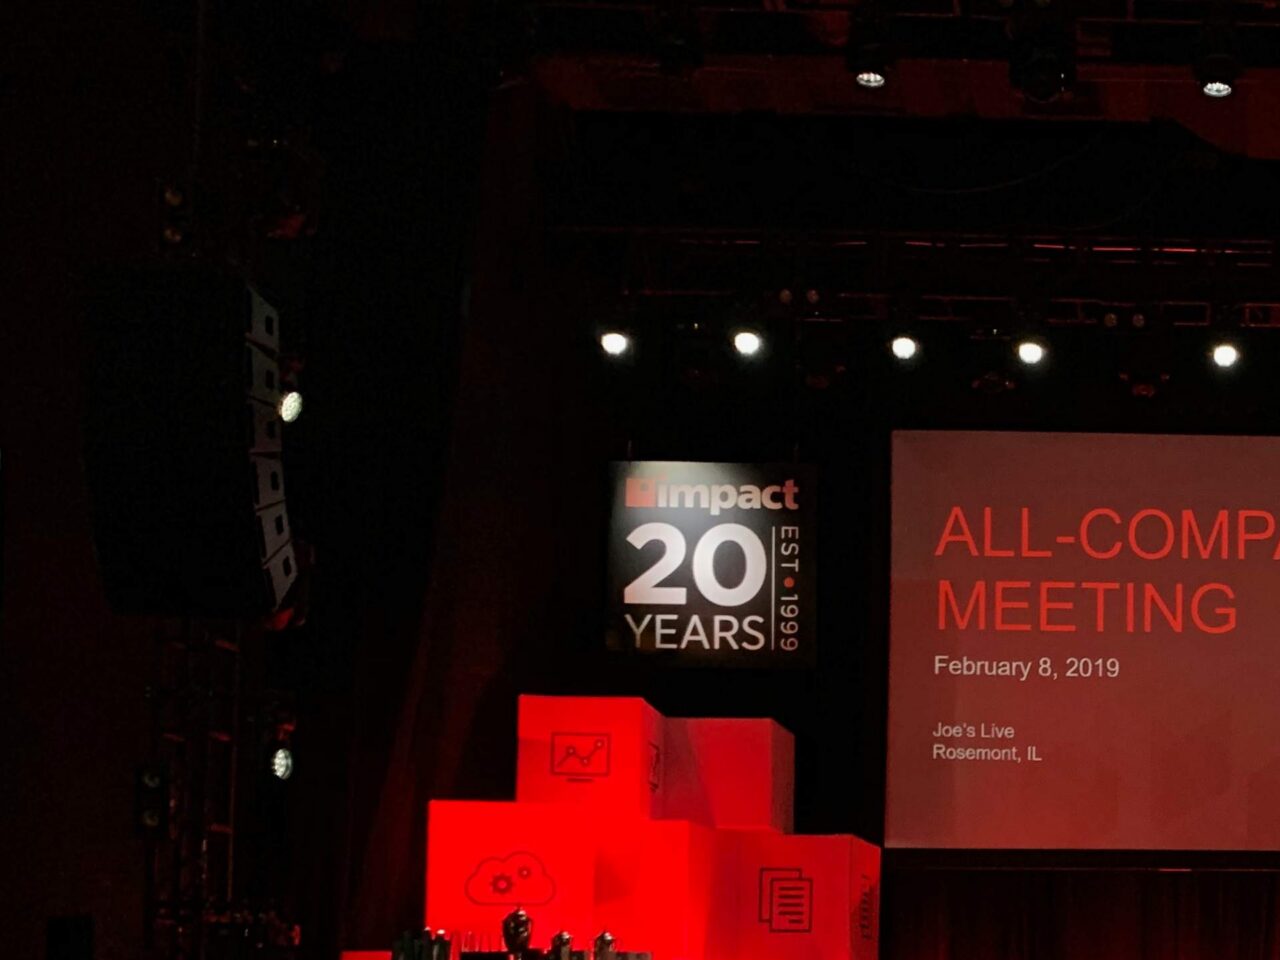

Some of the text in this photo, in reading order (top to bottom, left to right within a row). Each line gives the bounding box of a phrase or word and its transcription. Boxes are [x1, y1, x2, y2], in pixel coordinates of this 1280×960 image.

[657, 473, 800, 516] impact
[623, 522, 767, 607] 20
[780, 593, 800, 652] 1999
[936, 579, 1238, 634] MEETING
[624, 613, 766, 651] YEARS
[934, 655, 1120, 682] February 8, 2019
[932, 722, 1015, 739] Joe's Live
[932, 744, 1043, 763] Rosemont, IL
